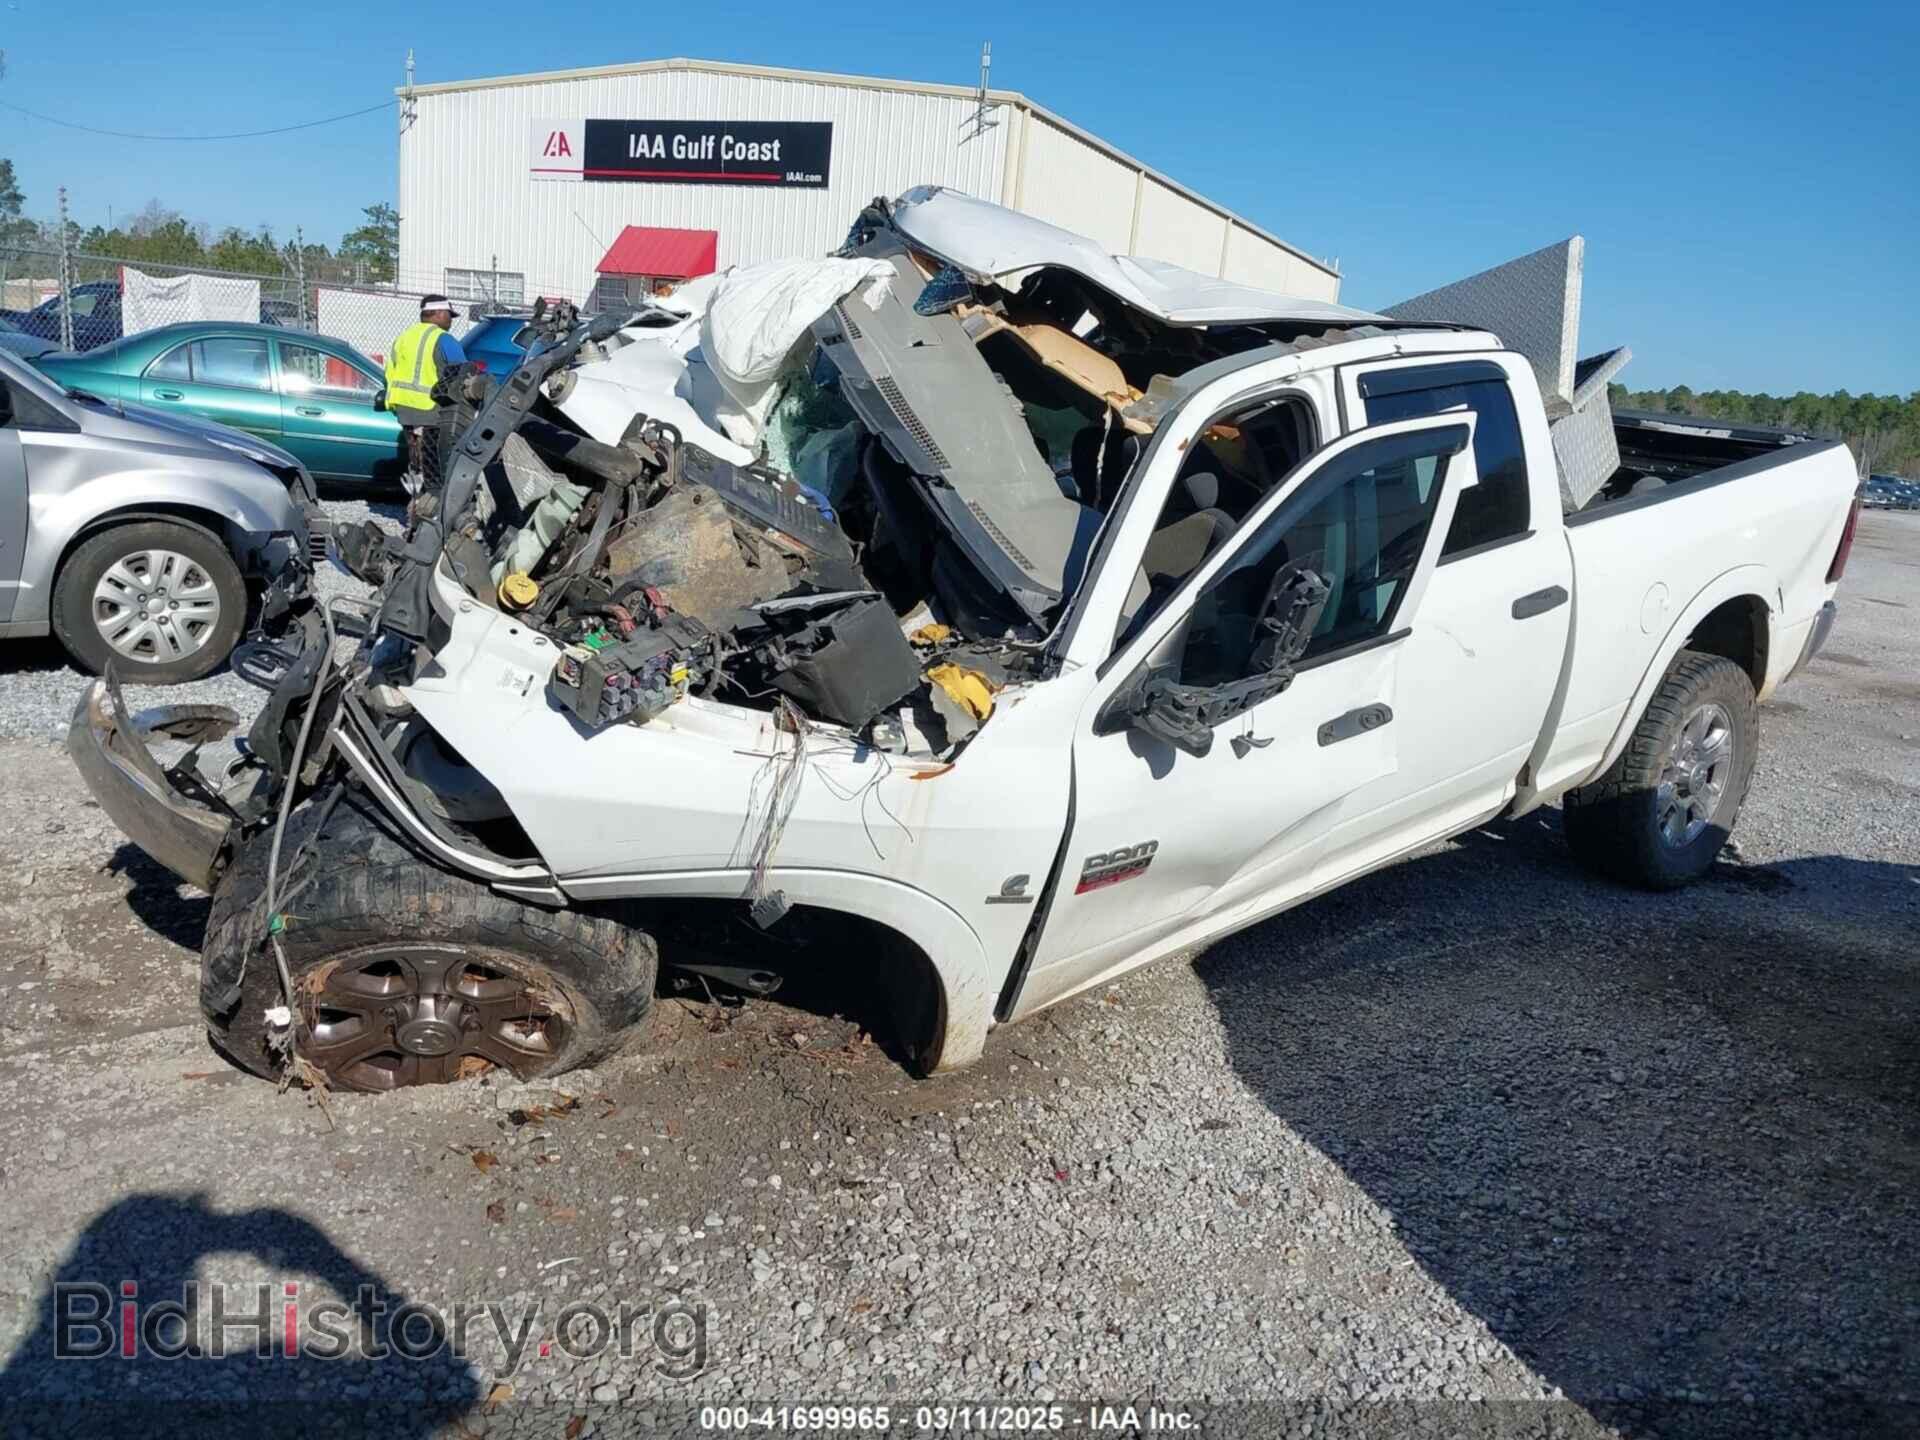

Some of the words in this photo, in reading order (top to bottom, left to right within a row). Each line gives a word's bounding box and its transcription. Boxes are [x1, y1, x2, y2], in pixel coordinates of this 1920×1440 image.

[629, 133, 666, 158] IAA
[672, 134, 715, 160] Gulf
[721, 135, 781, 161] Coast
